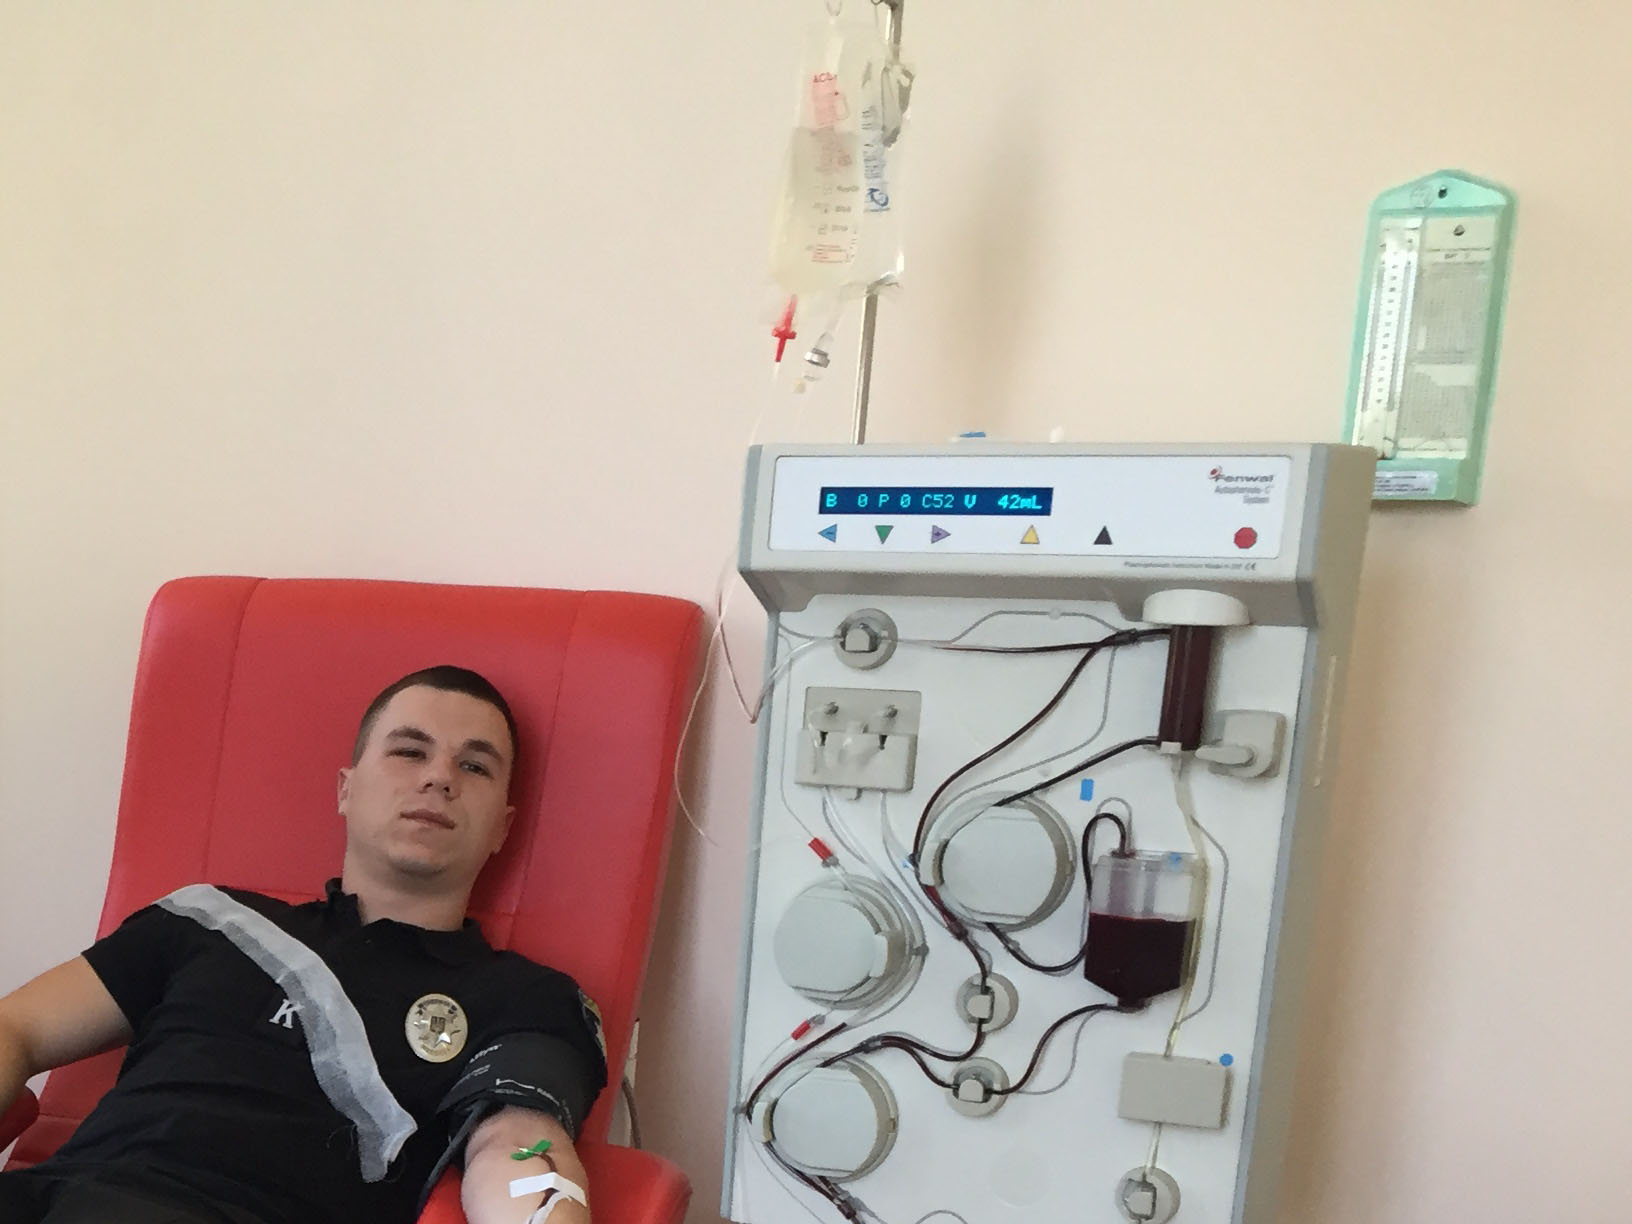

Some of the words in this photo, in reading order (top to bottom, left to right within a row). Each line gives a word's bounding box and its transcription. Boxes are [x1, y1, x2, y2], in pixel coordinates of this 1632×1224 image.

[825, 492, 838, 508] B
[878, 493, 890, 508] P
[921, 493, 955, 509] C52
[997, 494, 1043, 510] 42mL
